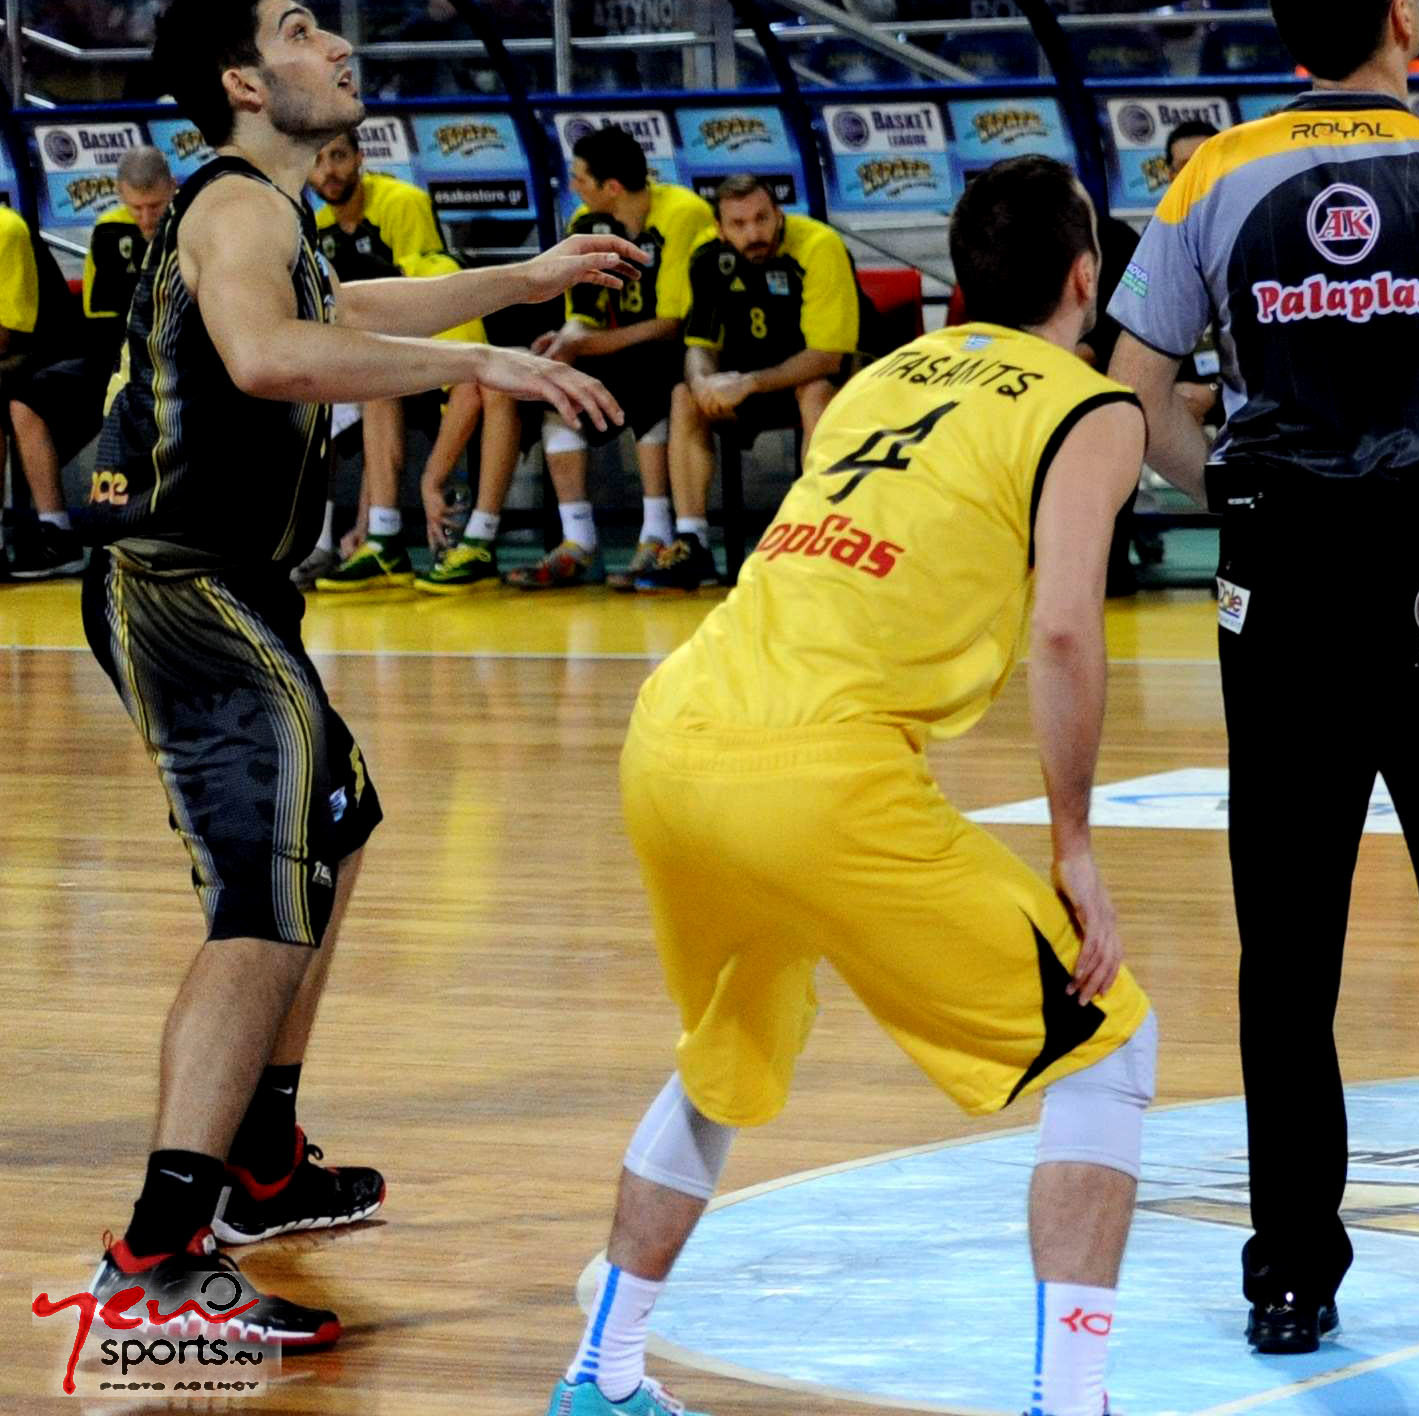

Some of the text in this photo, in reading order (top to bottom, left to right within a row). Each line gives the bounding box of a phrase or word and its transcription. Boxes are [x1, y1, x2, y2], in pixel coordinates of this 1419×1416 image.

[870, 109, 933, 130] BASKET
[1291, 121, 1394, 140] ROYAL
[78, 127, 134, 151] BASKET
[887, 134, 927, 147] LEAGUE
[1317, 206, 1372, 241] AK
[750, 307, 768, 339] 8
[819, 400, 960, 505] 4
[757, 514, 905, 579] opGas
